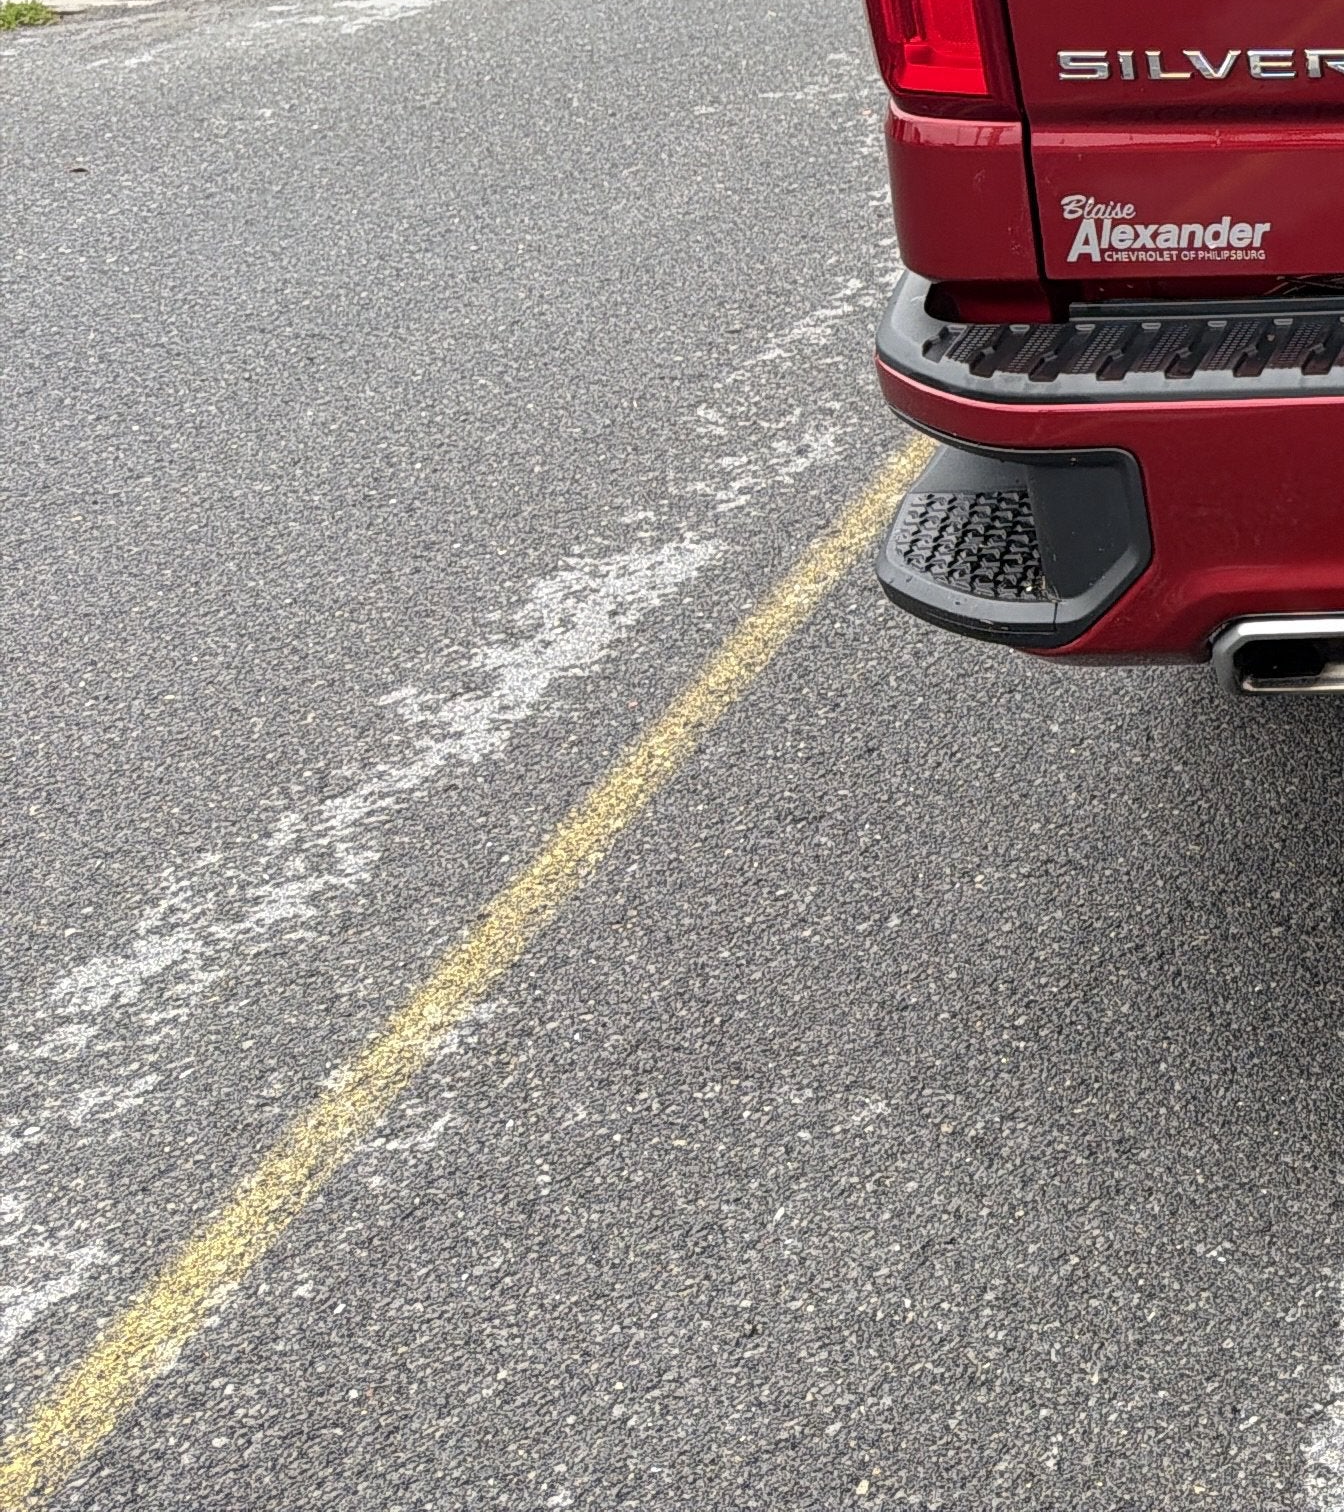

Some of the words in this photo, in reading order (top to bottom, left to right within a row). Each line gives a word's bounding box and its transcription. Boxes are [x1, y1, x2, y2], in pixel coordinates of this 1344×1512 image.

[1061, 194, 1136, 219] Blaise
[1067, 216, 1271, 262] Alexander
[1104, 250, 1178, 262] CHEVROLET
[1181, 250, 1196, 261] OF
[1198, 249, 1266, 261] PHILIPSBURG
